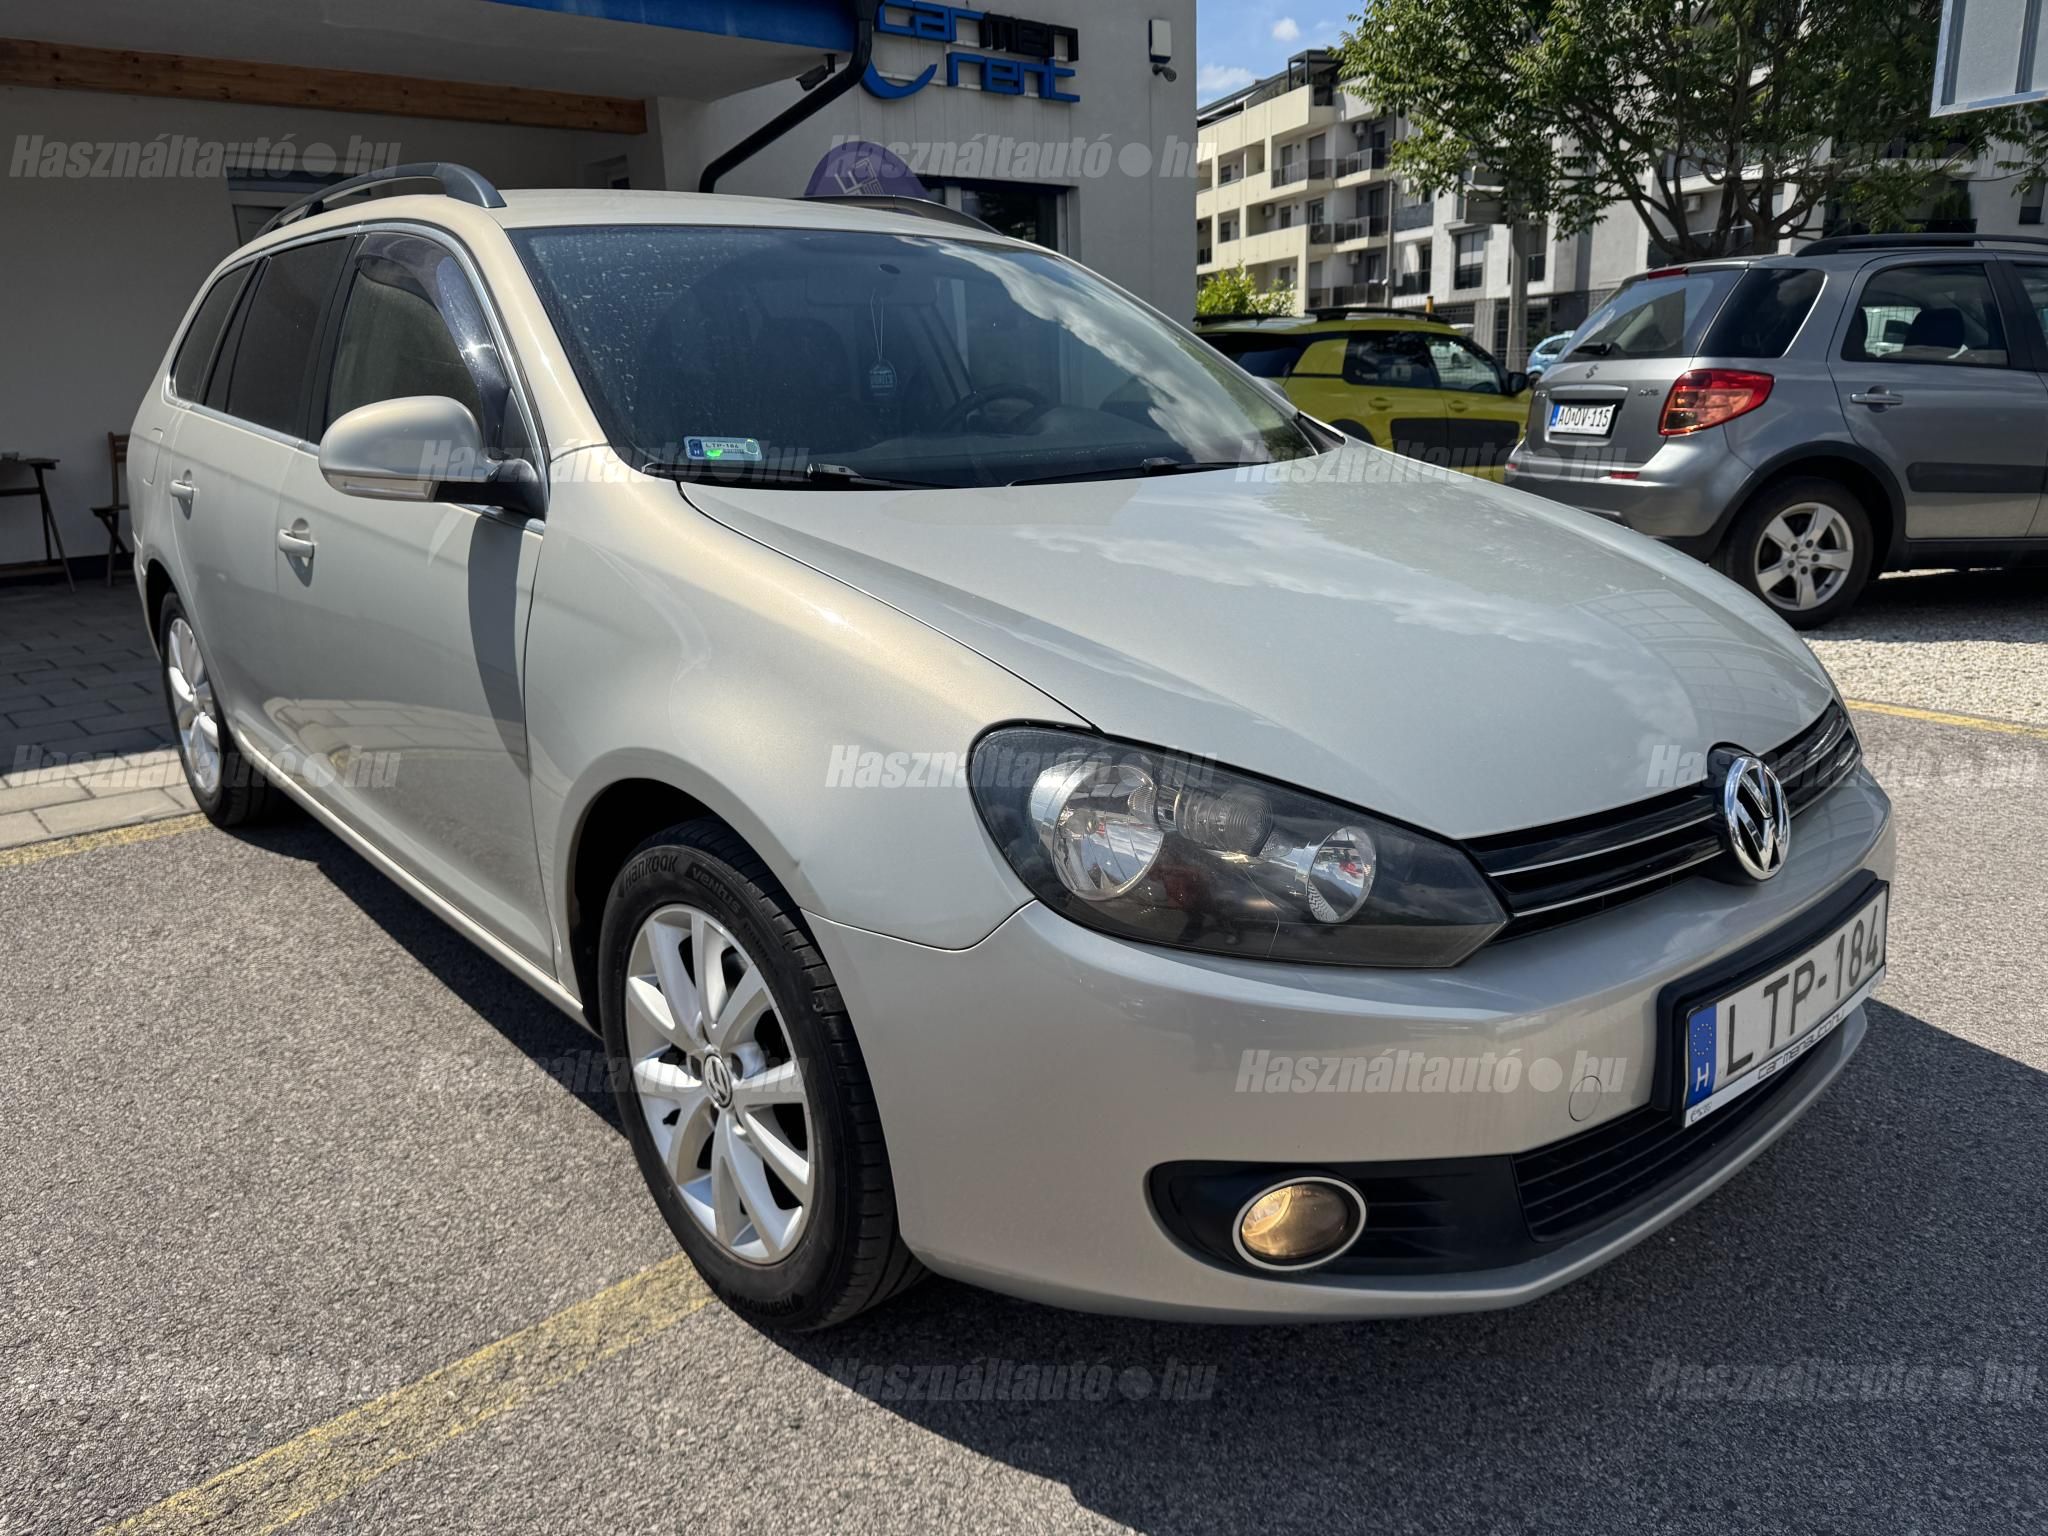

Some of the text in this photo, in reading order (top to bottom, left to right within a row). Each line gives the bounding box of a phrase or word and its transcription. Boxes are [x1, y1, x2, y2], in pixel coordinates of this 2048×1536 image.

[947, 51, 1081, 102] rent
[1726, 904, 1879, 1077] LTP-184
[1695, 1062, 1710, 1092] H
